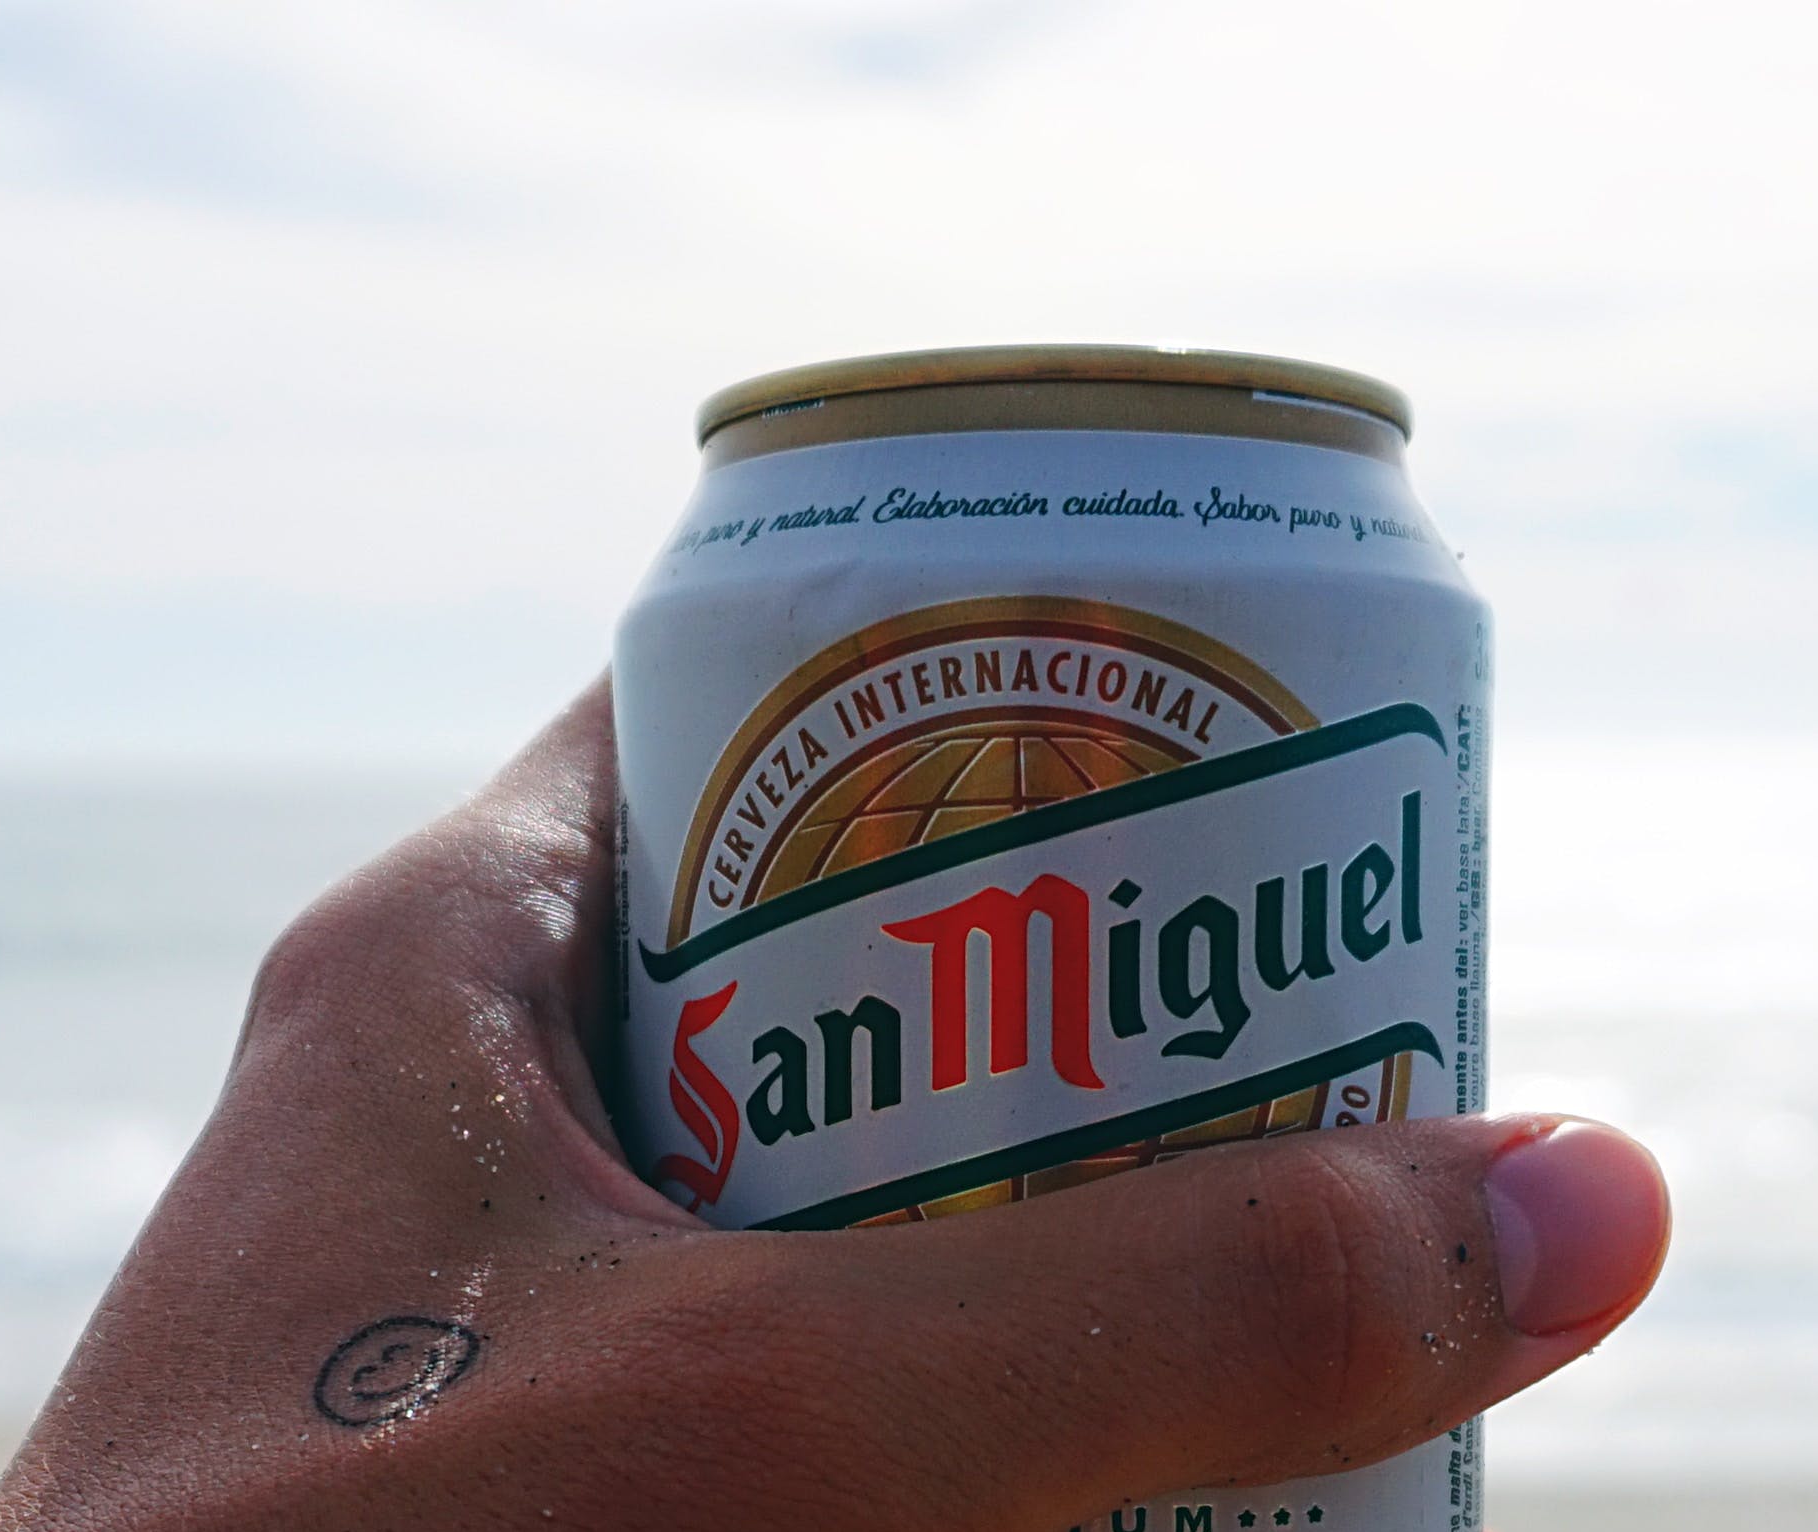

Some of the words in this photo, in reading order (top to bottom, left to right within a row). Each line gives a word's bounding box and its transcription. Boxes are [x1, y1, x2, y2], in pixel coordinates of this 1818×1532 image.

[739, 516, 767, 547] y
[768, 496, 862, 532] natural.
[872, 487, 1049, 524] Elaboración
[1062, 488, 1185, 518] cuidada.
[1194, 486, 1281, 527] Sabor
[1289, 505, 1341, 534] puro
[1350, 512, 1369, 542] y
[707, 727, 830, 910] CERVEZA
[832, 648, 1223, 745] INTERNACIONAL
[1456, 844, 1469, 893] base
[652, 980, 902, 1213] San
[881, 789, 1424, 1091] Miguel
[1455, 987, 1467, 1044] antes
[1448, 1450, 1461, 1507] malta
